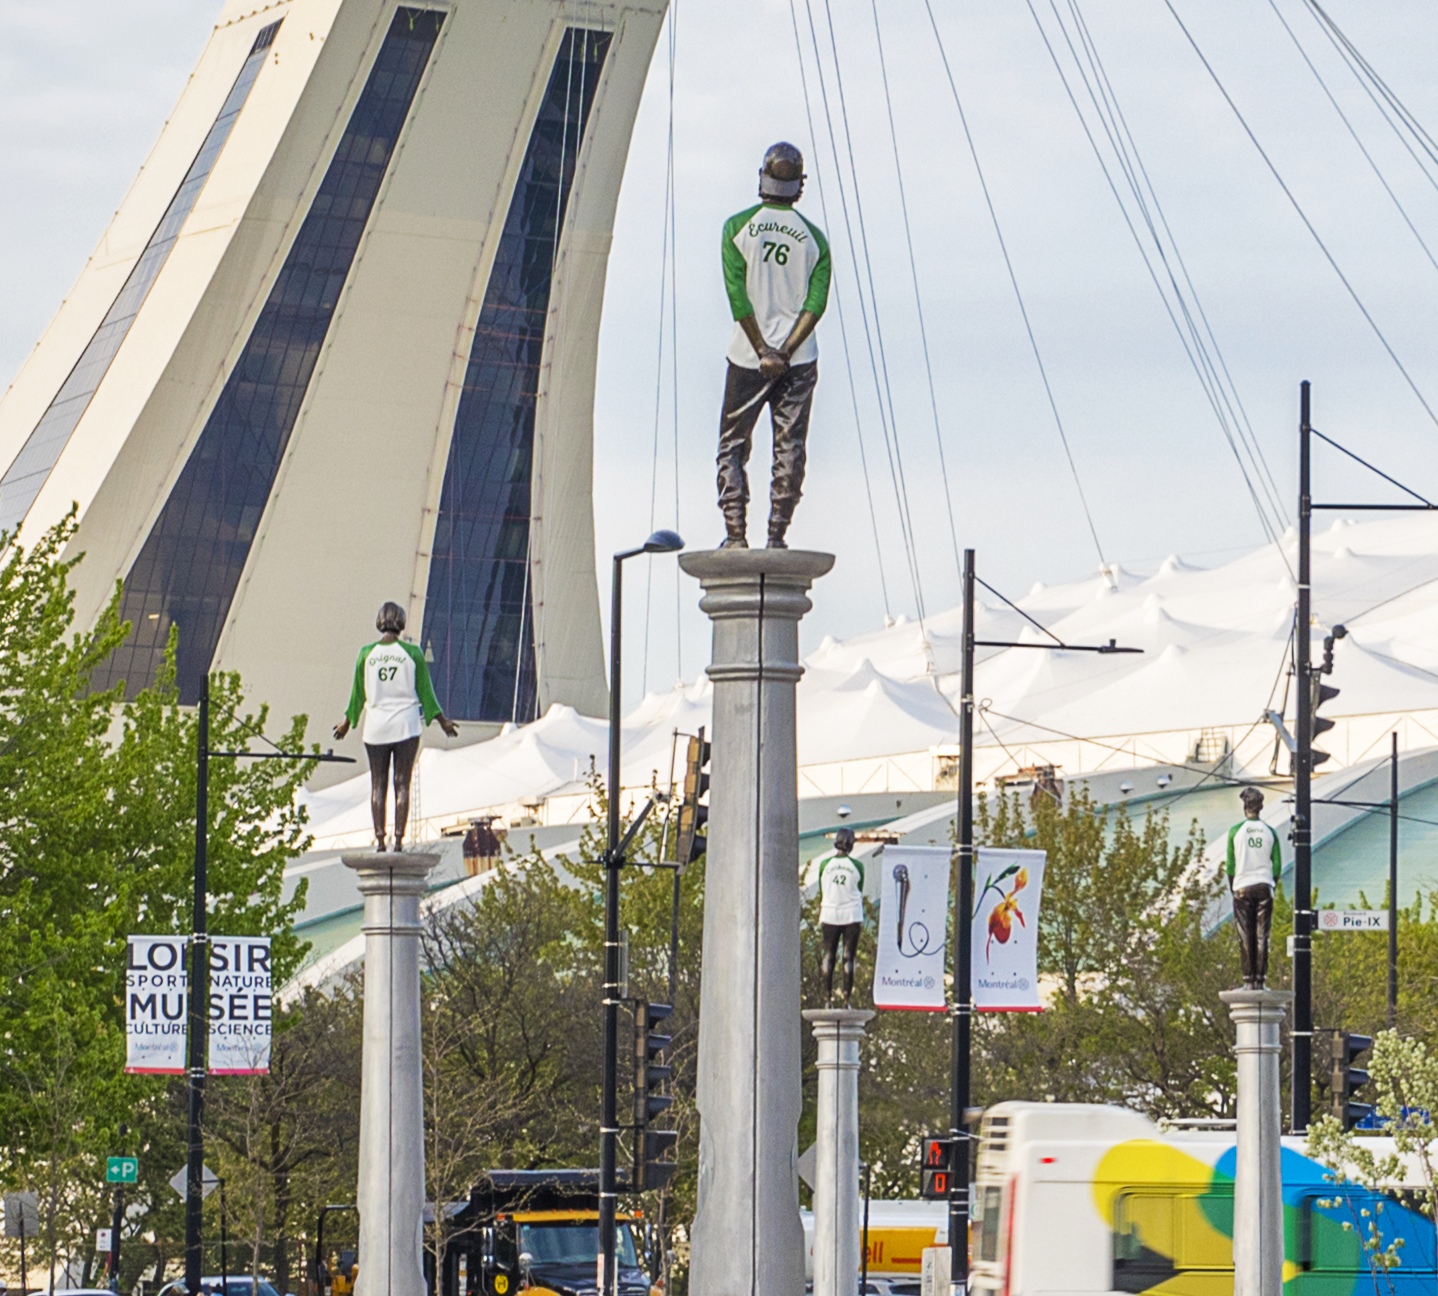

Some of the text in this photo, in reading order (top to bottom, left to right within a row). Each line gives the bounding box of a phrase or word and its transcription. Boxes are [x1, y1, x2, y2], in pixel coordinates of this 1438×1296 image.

[763, 241, 790, 265] 76
[378, 667, 398, 681] 67
[1248, 837, 1263, 849] 08
[832, 875, 847, 885] 42
[126, 975, 187, 987] SPORT
[210, 975, 271, 988] NATURE
[882, 976, 922, 987] Montréal
[978, 978, 1018, 989] Montréal
[126, 1023, 187, 1035] CULTURE
[209, 1023, 271, 1035] SCIENCE
[122, 1161, 135, 1178] P
